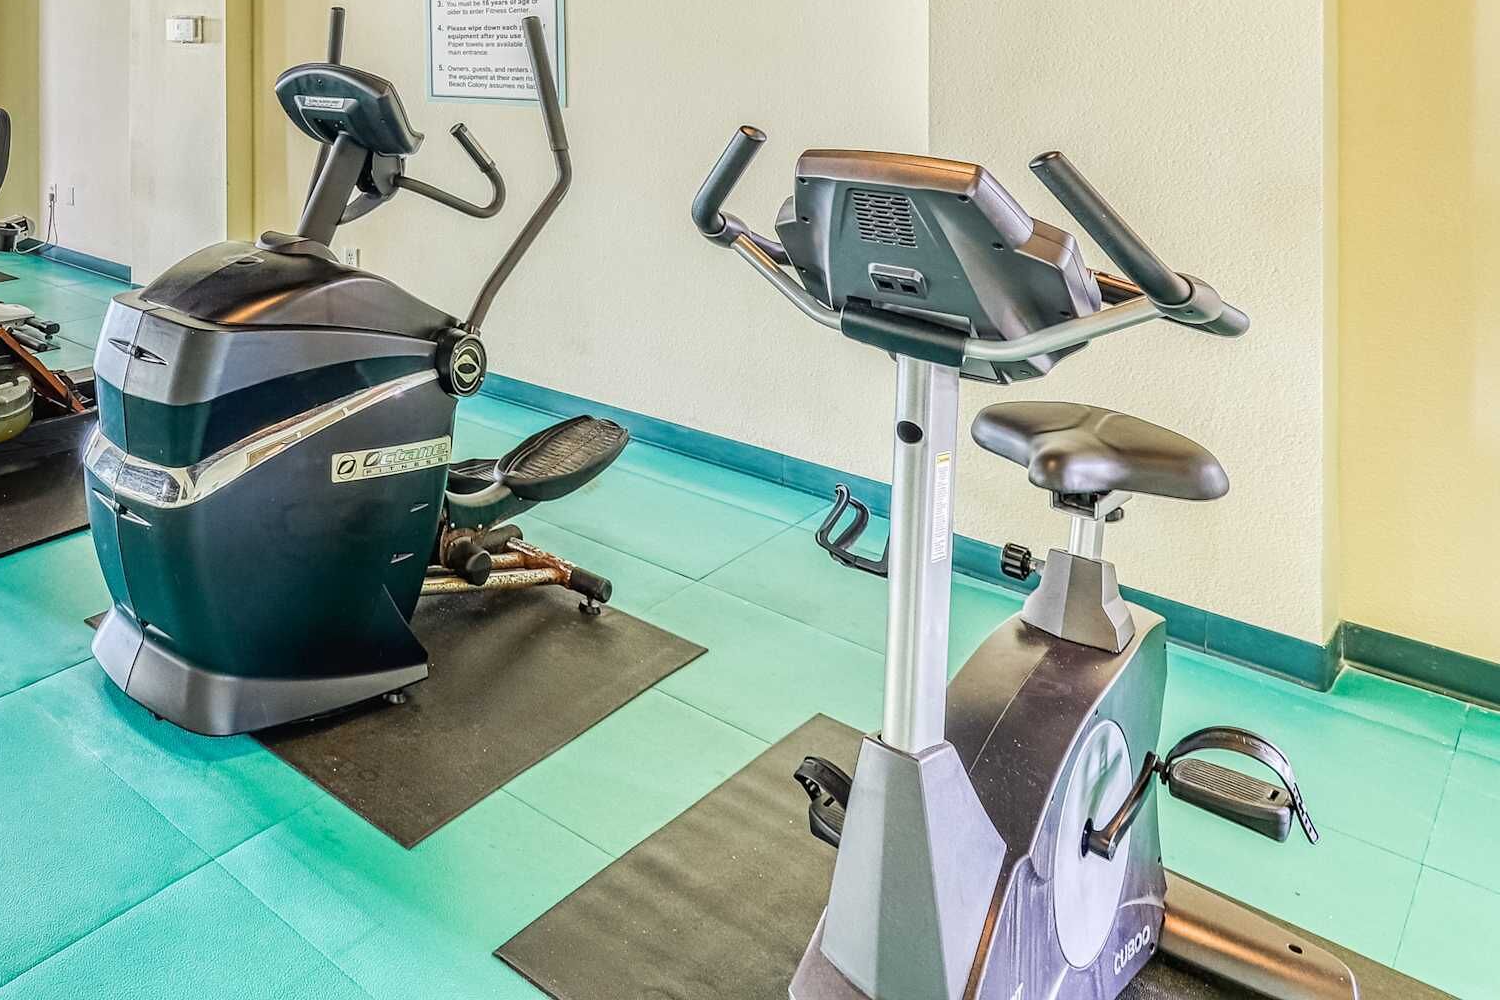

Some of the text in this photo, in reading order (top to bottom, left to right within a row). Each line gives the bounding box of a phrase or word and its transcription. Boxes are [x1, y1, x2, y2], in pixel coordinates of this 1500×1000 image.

[468, 24, 482, 32] wipe
[467, 81, 488, 89] Colony
[363, 441, 448, 467] Octane
[1112, 924, 1151, 976] CU800
